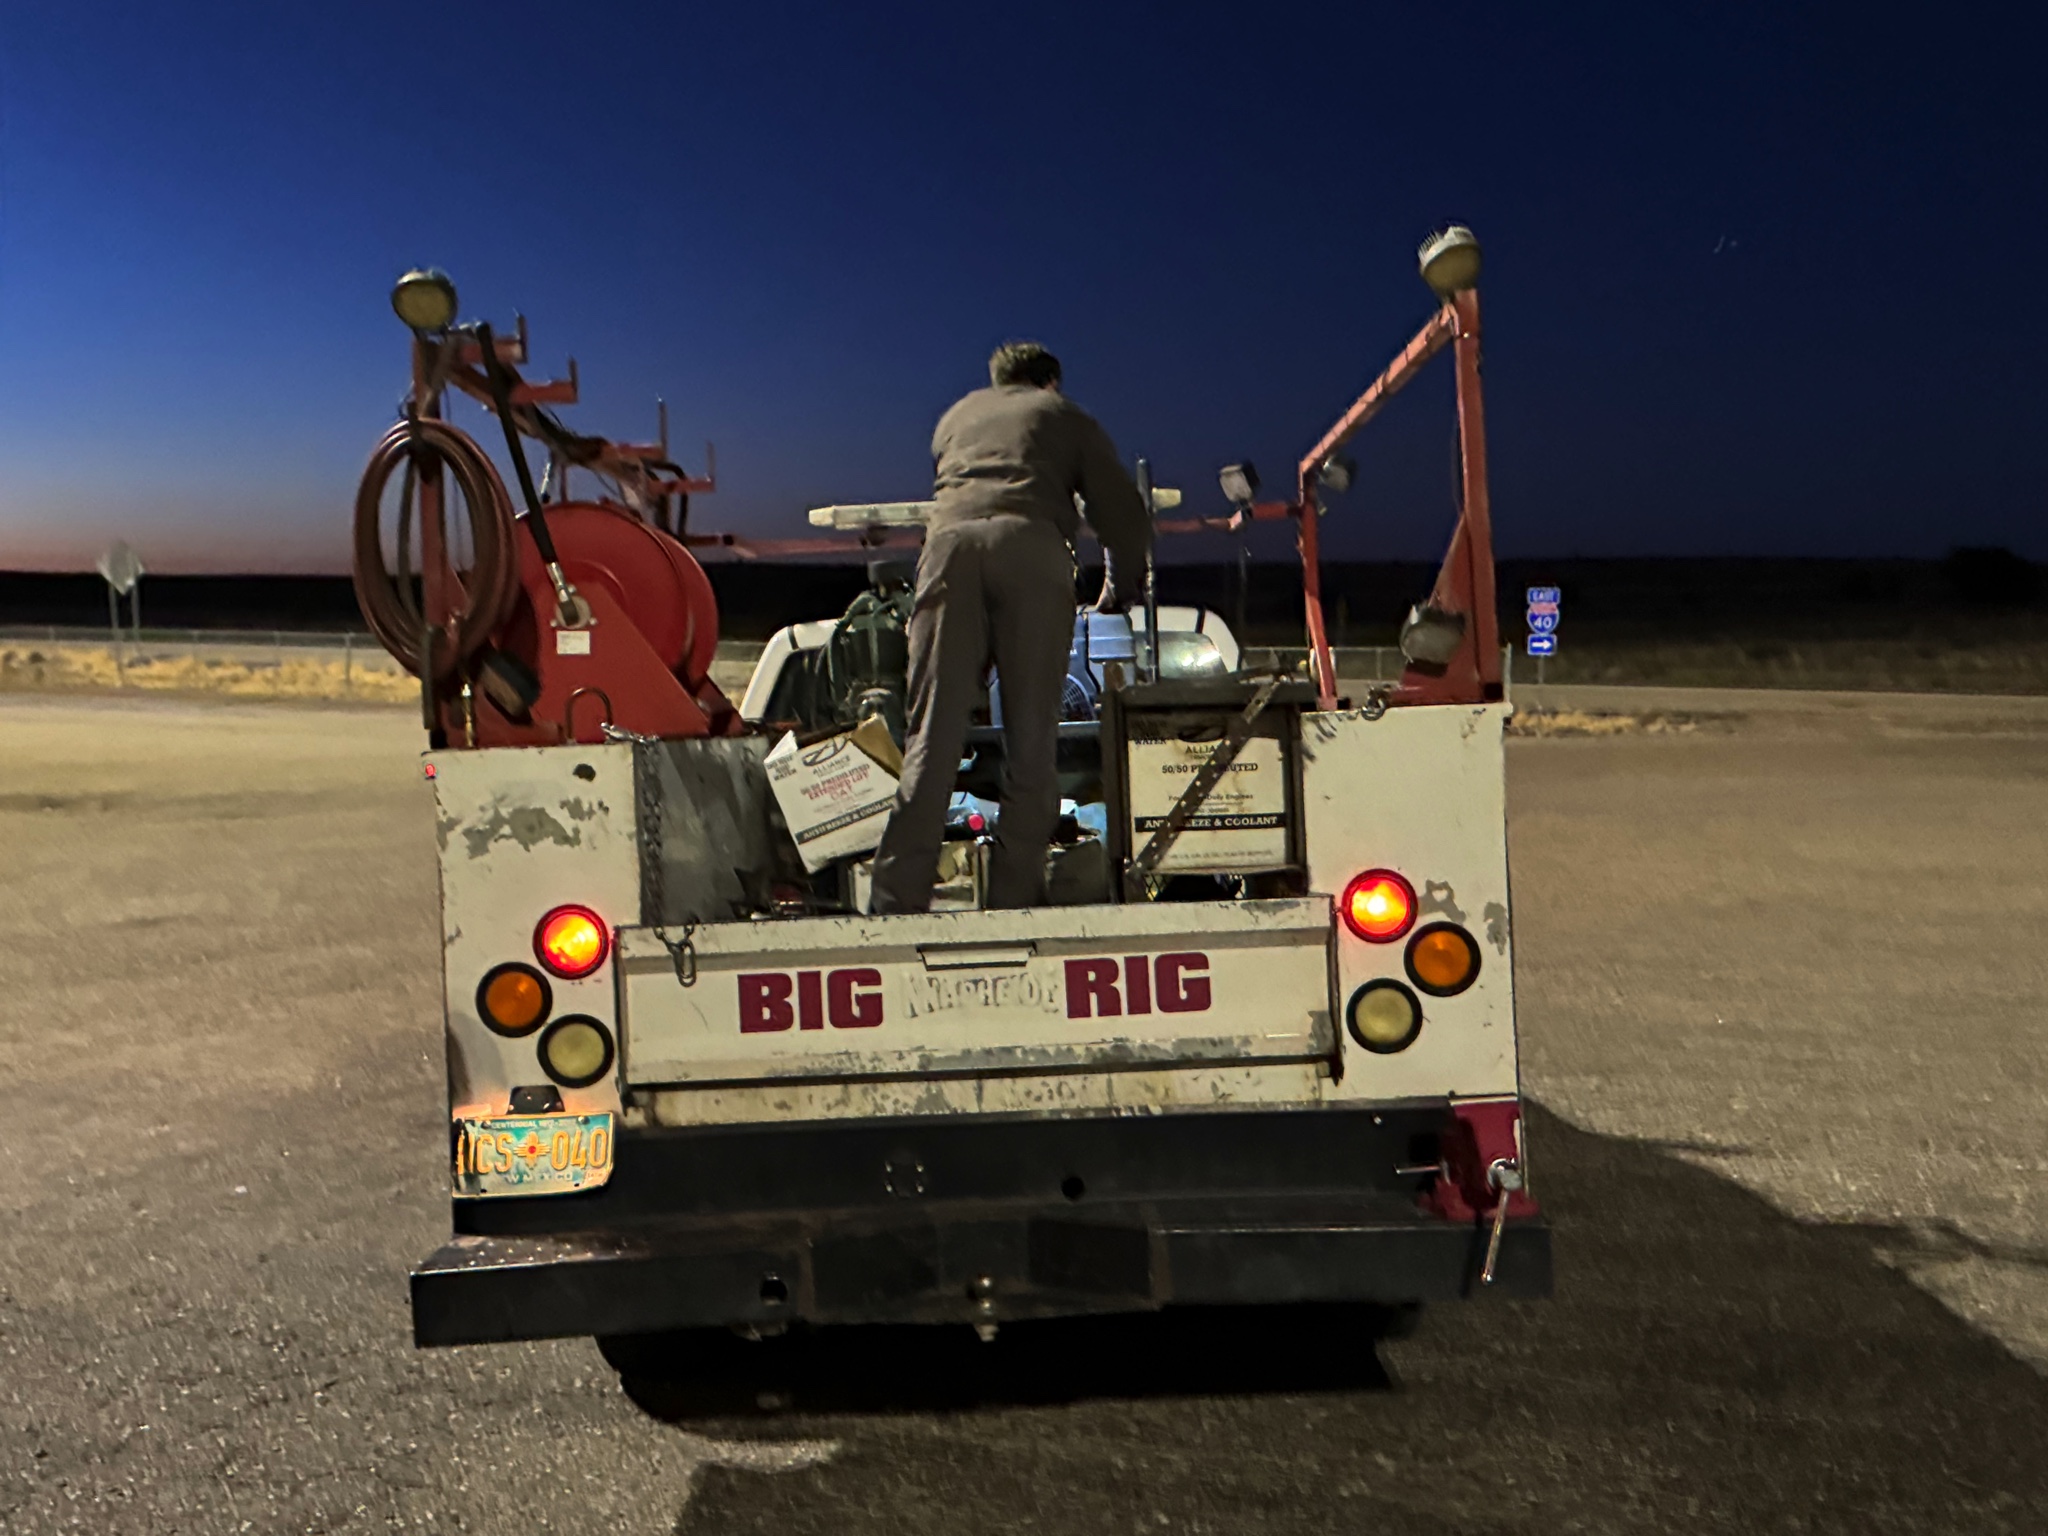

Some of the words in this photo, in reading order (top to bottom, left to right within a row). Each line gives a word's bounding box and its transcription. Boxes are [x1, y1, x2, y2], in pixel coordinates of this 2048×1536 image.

[1533, 616, 1553, 629] 40
[1162, 765, 1188, 774] 50/50
[1213, 818, 1222, 827] &
[1224, 816, 1278, 827] COOLANT
[737, 968, 884, 1034] BIG
[1064, 951, 1212, 1019] RIG
[551, 1128, 608, 1171] 040
